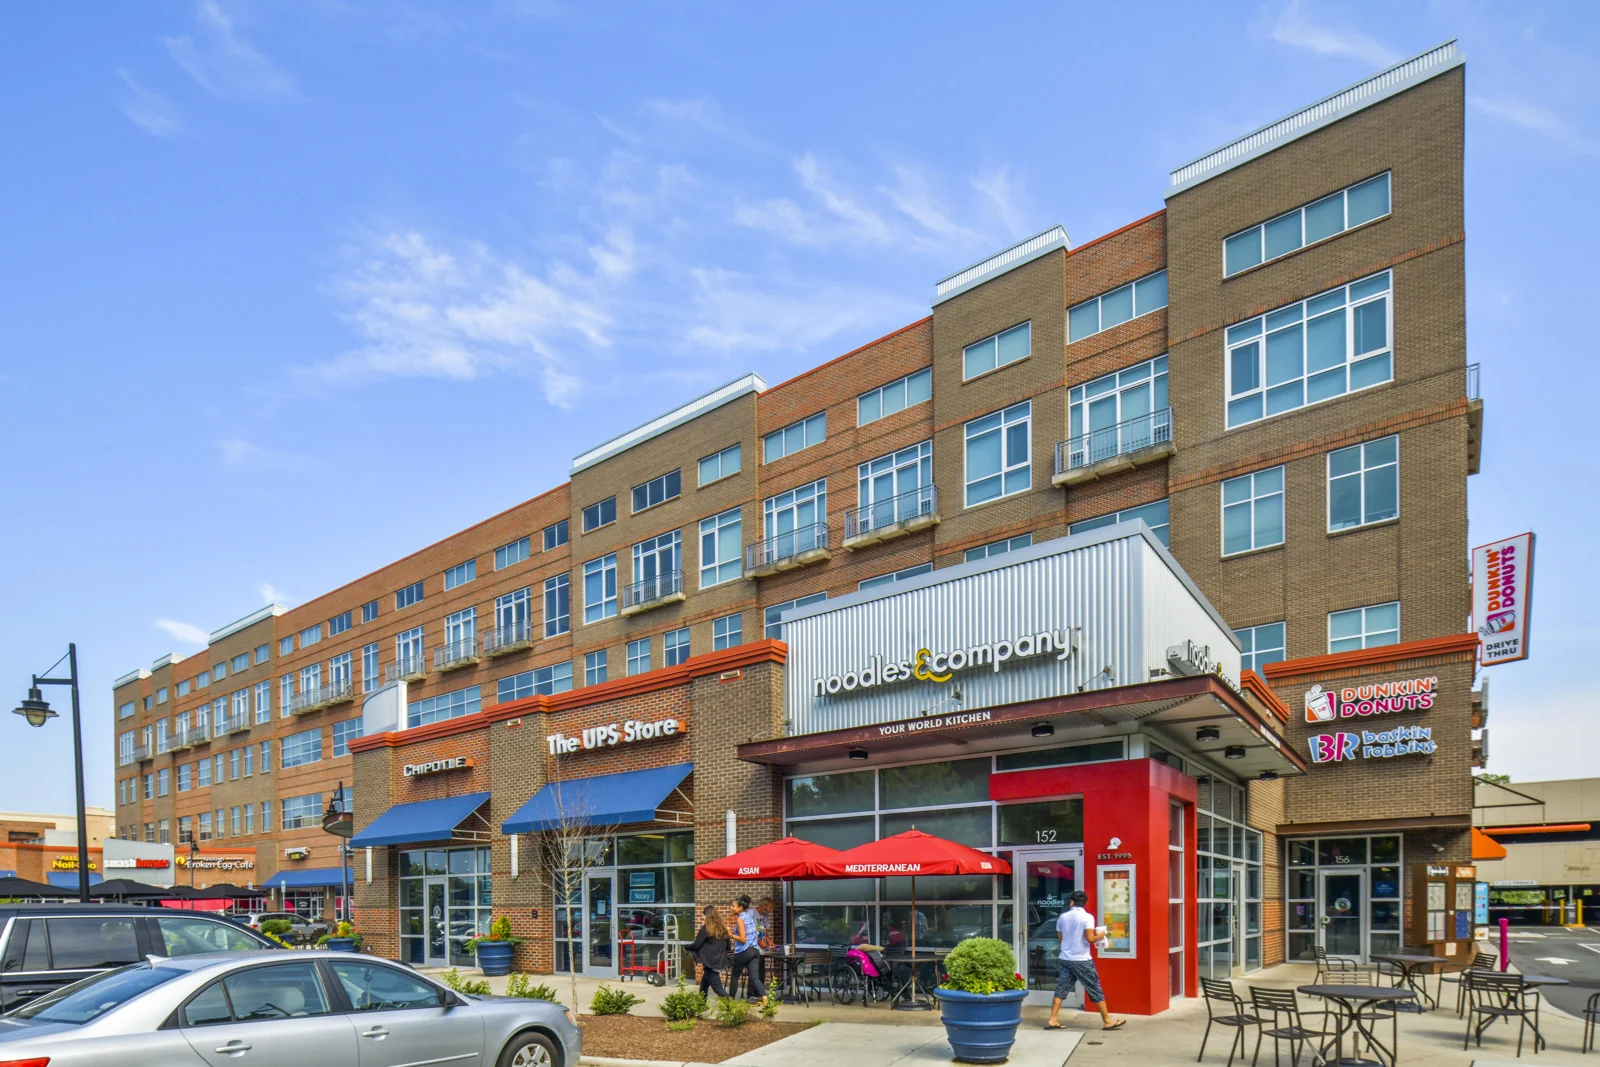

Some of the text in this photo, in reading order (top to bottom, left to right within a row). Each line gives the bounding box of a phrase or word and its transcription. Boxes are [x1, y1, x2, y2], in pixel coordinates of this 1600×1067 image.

[1485, 549, 1500, 612] DUNKIN'
[1501, 545, 1516, 608] DONUTS
[1486, 638, 1519, 651] DRIVE
[1487, 647, 1517, 658] THRU
[813, 653, 911, 697] noodles
[932, 626, 1071, 673] company
[1341, 676, 1437, 702] DUNKIN'
[1340, 693, 1435, 717] DONUTS
[879, 711, 991, 736] YOUR WORLD KITCHEN
[546, 718, 681, 755] The UPS Store
[403, 756, 468, 776] CHIPOTLE
[1035, 829, 1057, 843] 152
[52, 860, 75, 869] Nail
[217, 860, 233, 870] Egg
[845, 863, 921, 873] MEDITERRANEAN
[1335, 855, 1350, 864] 156
[738, 867, 760, 875] ASIAN
